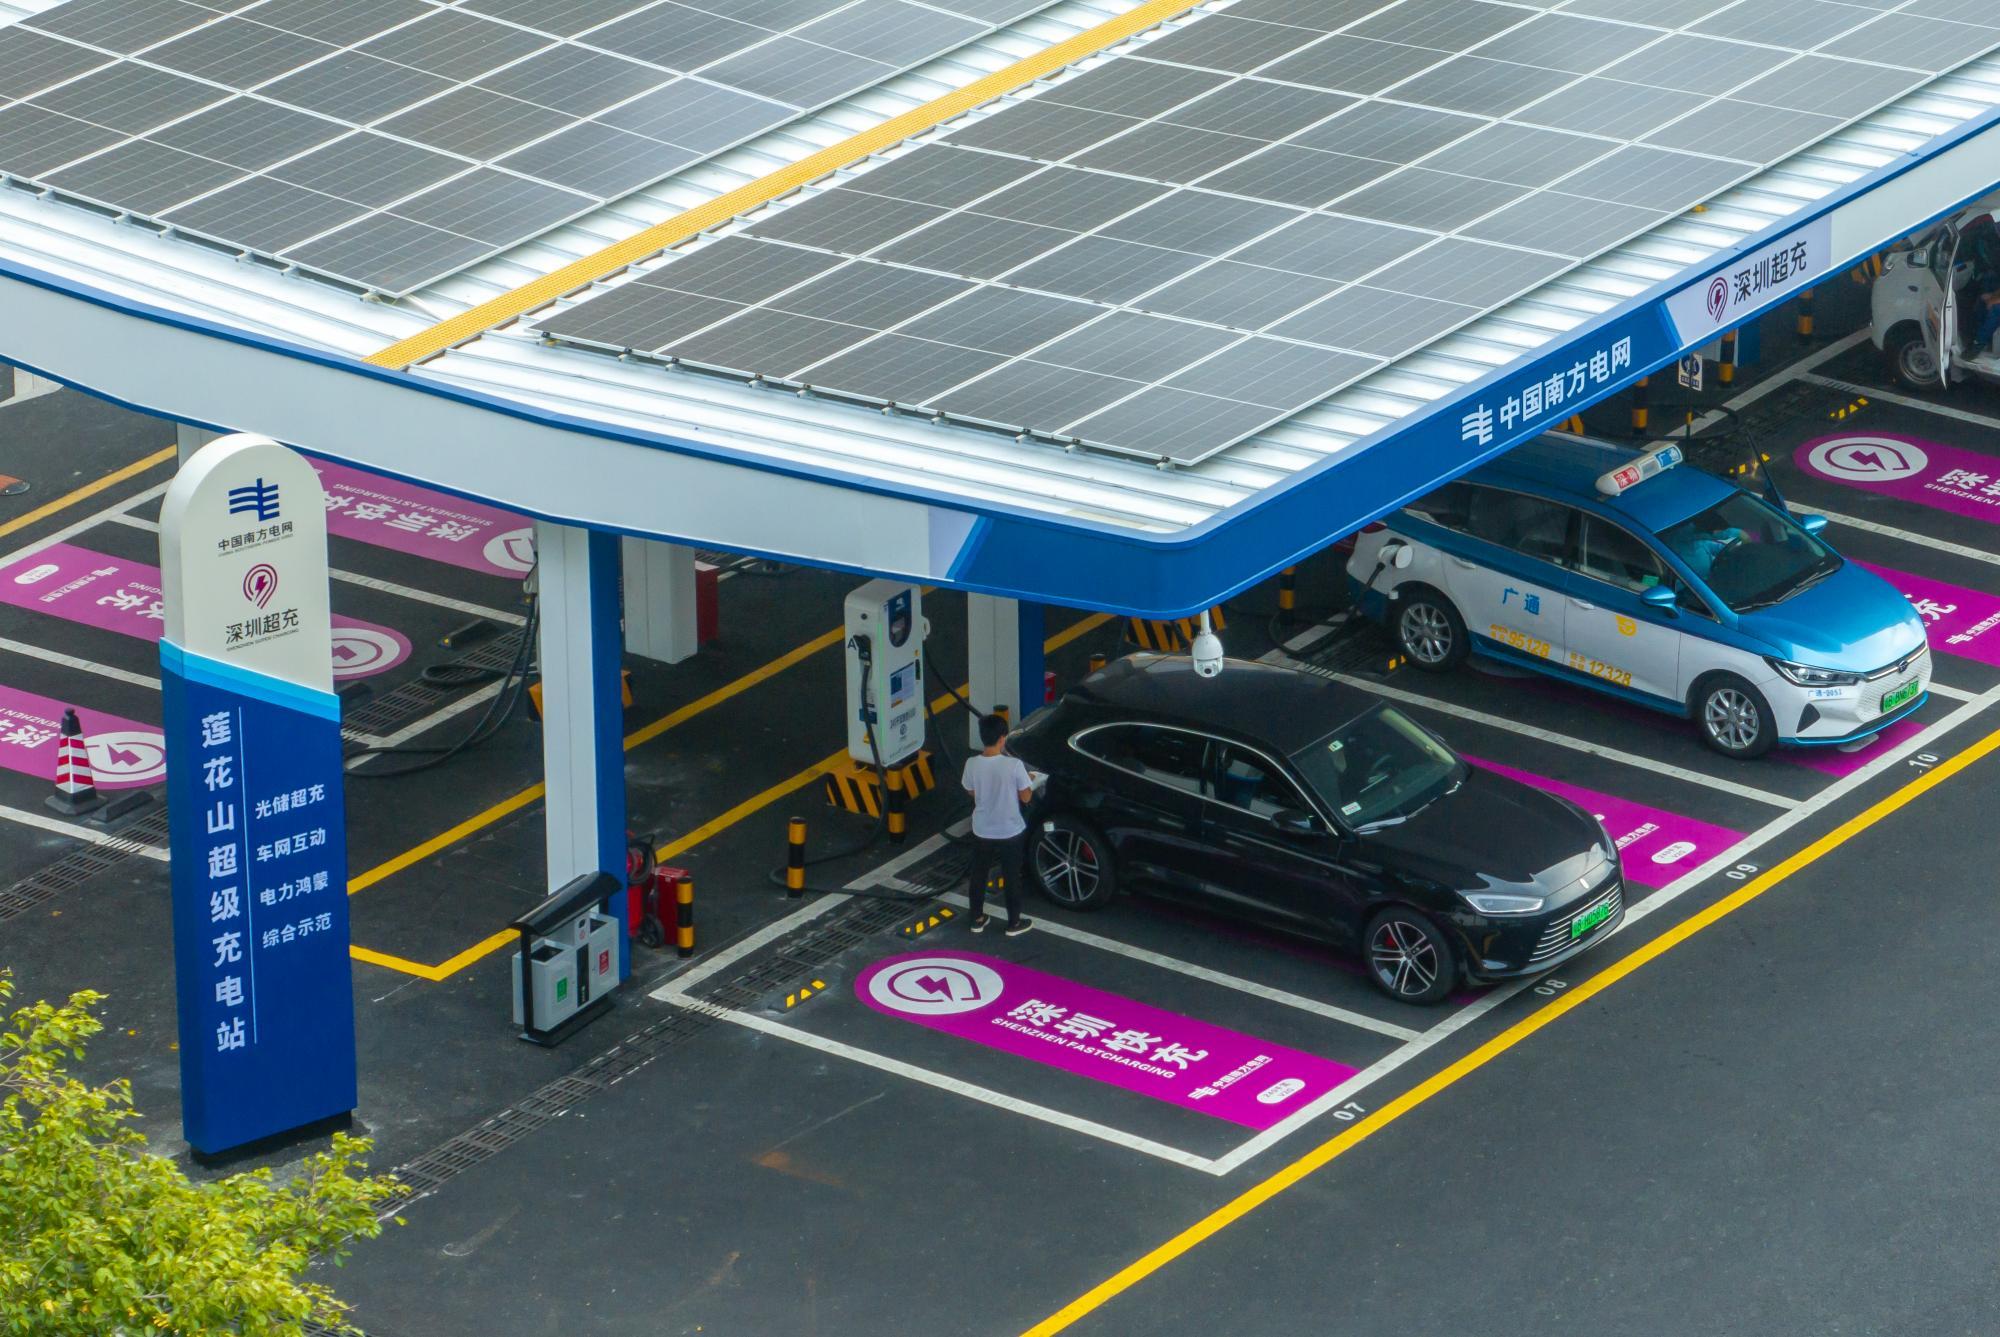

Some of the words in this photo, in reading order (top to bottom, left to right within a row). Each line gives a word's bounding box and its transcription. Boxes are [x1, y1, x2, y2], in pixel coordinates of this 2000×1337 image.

[1734, 240, 1807, 305] 深圳超充
[1500, 336, 1631, 430] 中国南方电网
[1923, 483, 1995, 505] SHENZHEN
[218, 521, 293, 551] 中国南方电网
[1502, 587, 1540, 616] 广通
[226, 608, 299, 645] 深圳超充
[1508, 631, 1551, 658] 95128
[1589, 660, 1632, 687] 12328
[255, 783, 325, 820] 光储超充
[256, 827, 327, 863] 车网互动
[201, 711, 246, 1052] 莲花山超级充电站
[260, 870, 329, 907] 电力鸿蒙
[1725, 863, 1759, 880] 09
[262, 912, 332, 949] 综合示范
[1533, 979, 1568, 995] 08
[991, 1017, 1068, 1045] SHENZHEN
[1066, 1041, 1177, 1079] FASTCHARGING
[1007, 999, 1209, 1070] 深圳快充
[1333, 1101, 1366, 1121] 07
